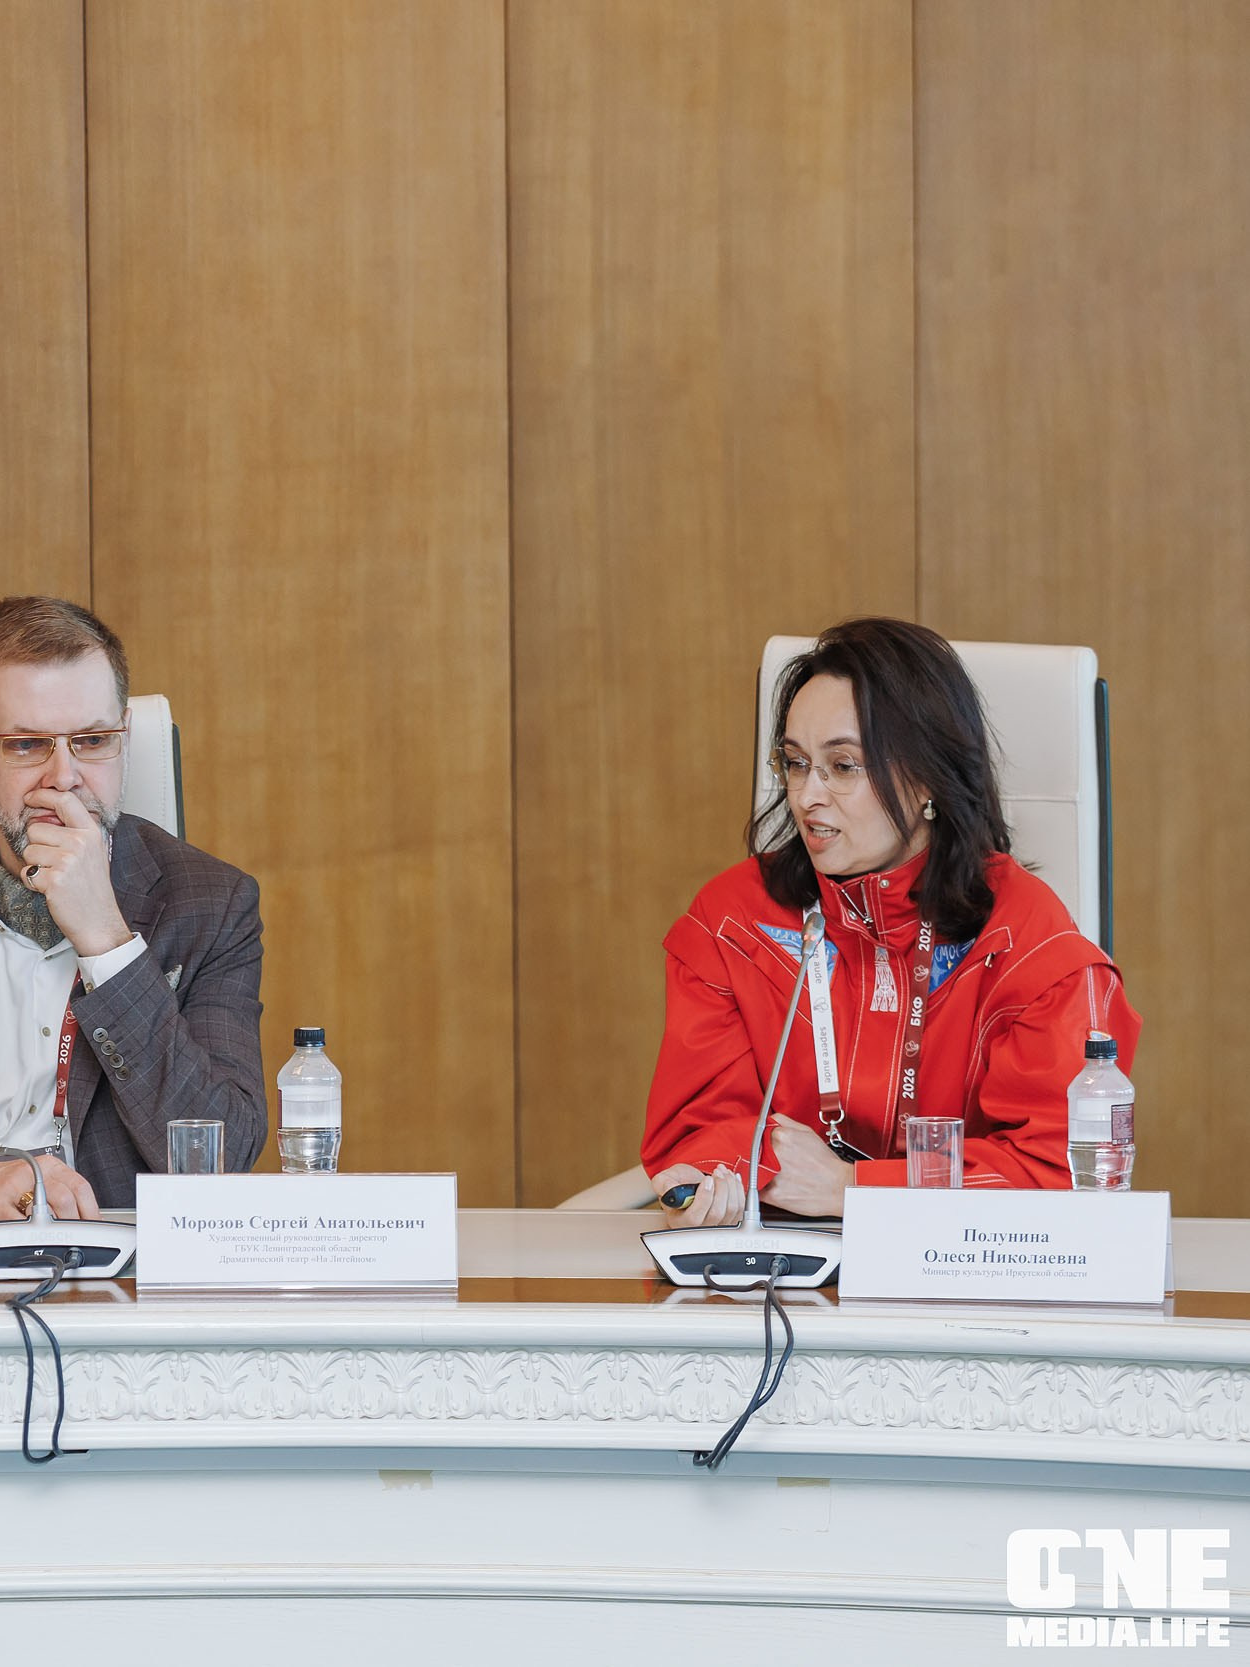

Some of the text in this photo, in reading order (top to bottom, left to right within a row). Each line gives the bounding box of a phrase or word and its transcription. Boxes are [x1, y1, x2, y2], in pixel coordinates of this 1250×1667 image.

[813, 961, 823, 984] aude
[910, 996, 924, 1027] БКФ
[59, 1034, 72, 1065] 2026
[819, 1026, 833, 1084] sapere aude
[902, 1067, 916, 1100] 2026
[170, 1215, 425, 1232] Морозов Сергей Анатольевич
[208, 1233, 281, 1243] Художественный
[283, 1235, 341, 1243] руководитель
[348, 1234, 388, 1244] директор
[963, 1228, 1050, 1246] Полунина
[234, 1244, 361, 1254] ГБУК Ленинградской области
[924, 1248, 1087, 1265] Олеся Николаевна
[218, 1255, 284, 1264] Драматический
[286, 1256, 309, 1265] театр
[921, 1267, 1088, 1278] Министр культуры Иркутской области
